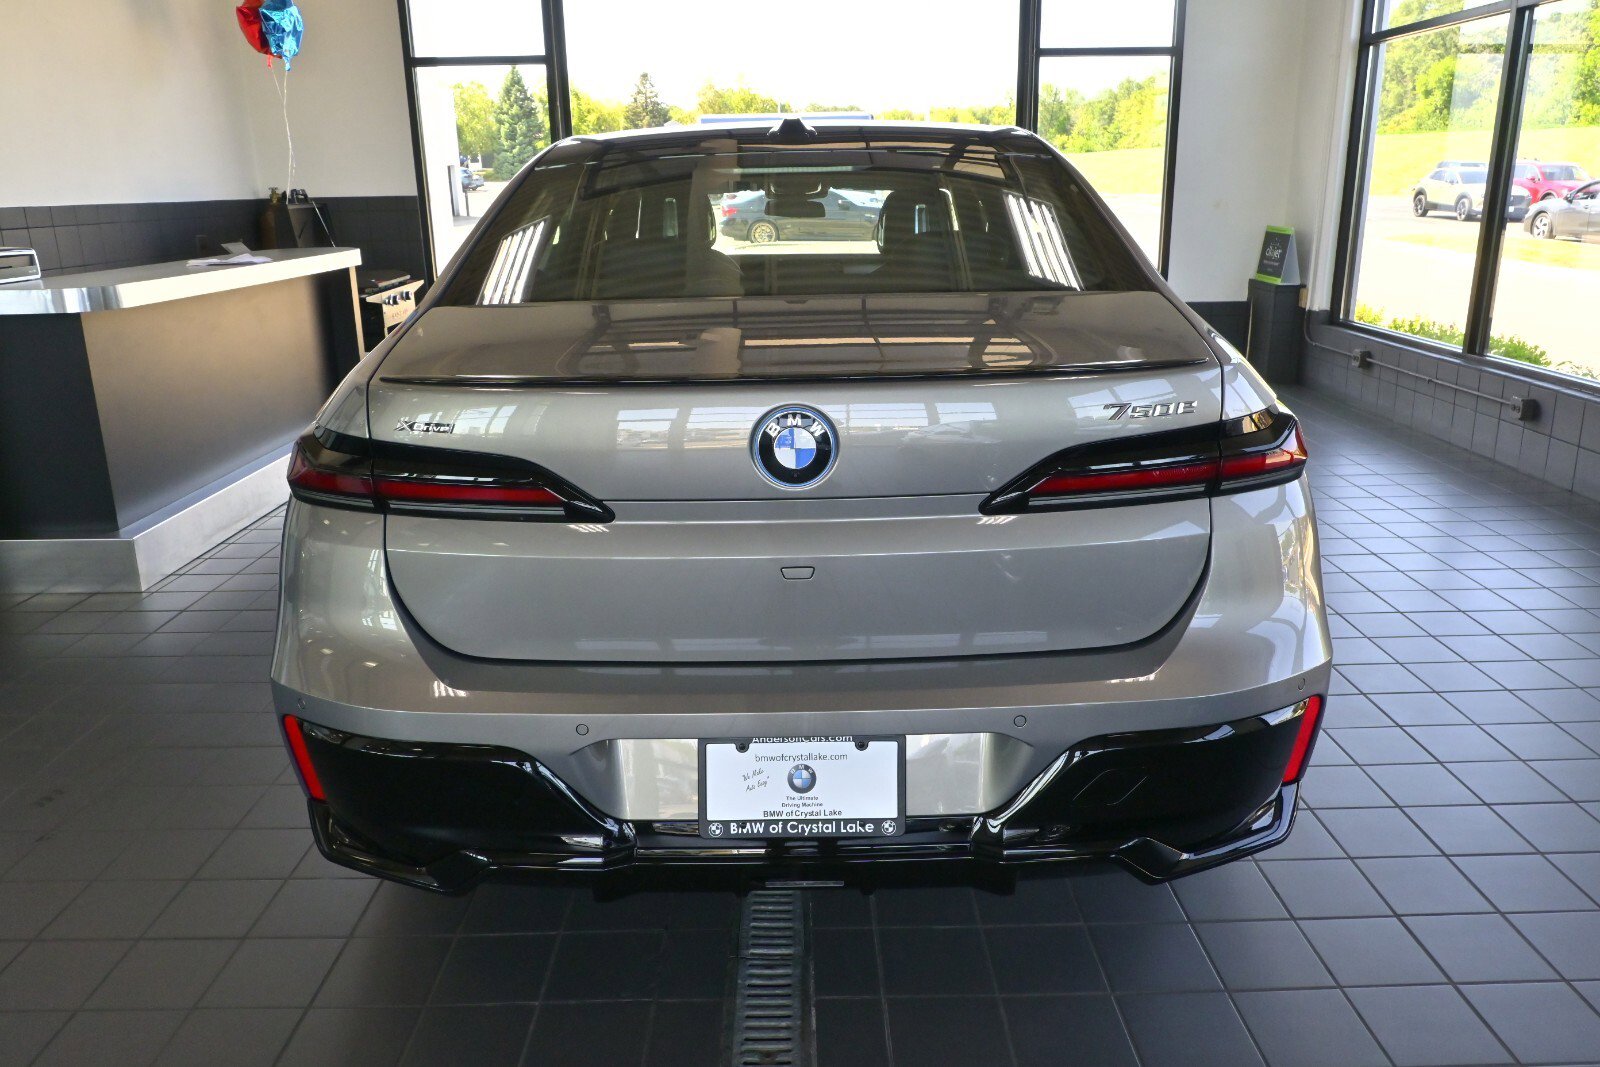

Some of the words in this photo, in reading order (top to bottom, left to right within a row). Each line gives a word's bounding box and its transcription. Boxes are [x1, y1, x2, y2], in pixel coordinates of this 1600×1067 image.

[765, 413, 825, 437] BMW
[755, 753, 848, 762] bmwofcrystallake.com
[763, 810, 784, 818] BMW
[794, 809, 822, 819] Crystal
[823, 809, 843, 817] Lake
[730, 822, 765, 834] BMW
[769, 821, 783, 833] of
[786, 821, 836, 836] Crystal
[840, 820, 875, 833] Lake
